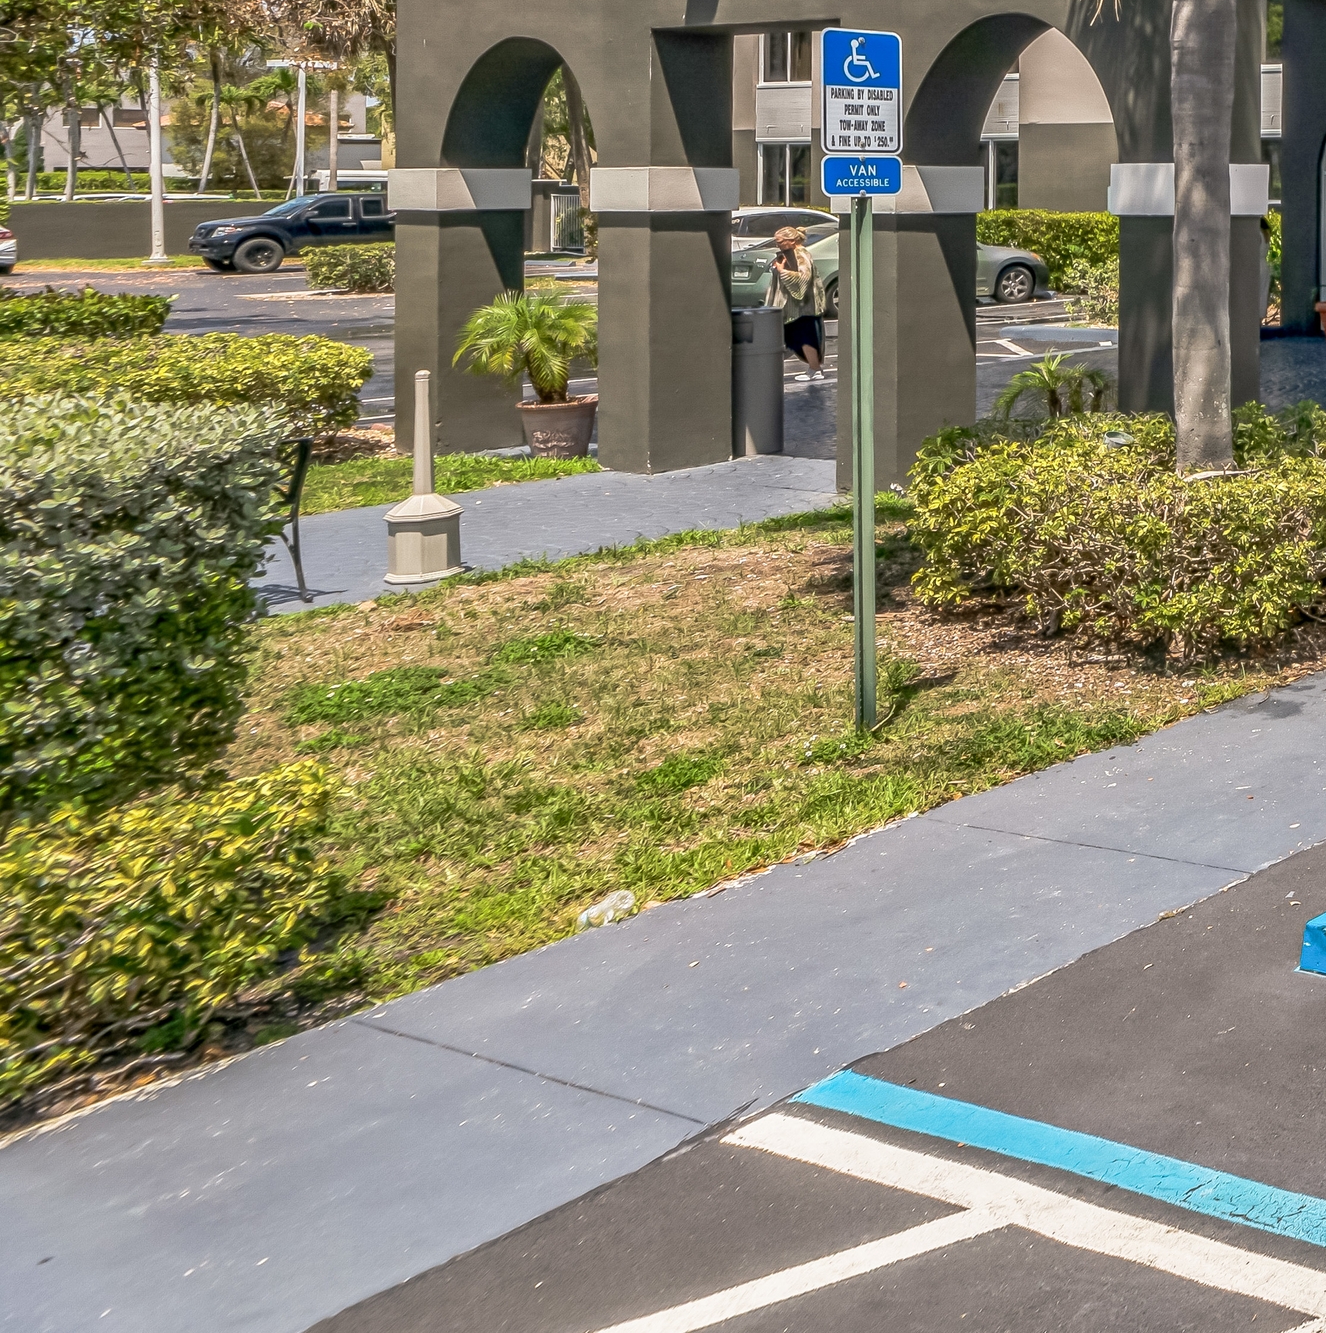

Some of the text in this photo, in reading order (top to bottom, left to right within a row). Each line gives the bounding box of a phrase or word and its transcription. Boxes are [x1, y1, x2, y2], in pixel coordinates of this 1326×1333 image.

[830, 87, 894, 101] PARKING BY DISABLED
[844, 104, 880, 116] PERMIT ONLY
[839, 119, 886, 132] TOW-AWAY ZONE
[831, 134, 836, 147] &
[838, 135, 851, 147] FINE
[853, 135, 862, 147] UP
[863, 135, 872, 147] TO
[836, 164, 890, 187] VAN ACCESSIBLE
